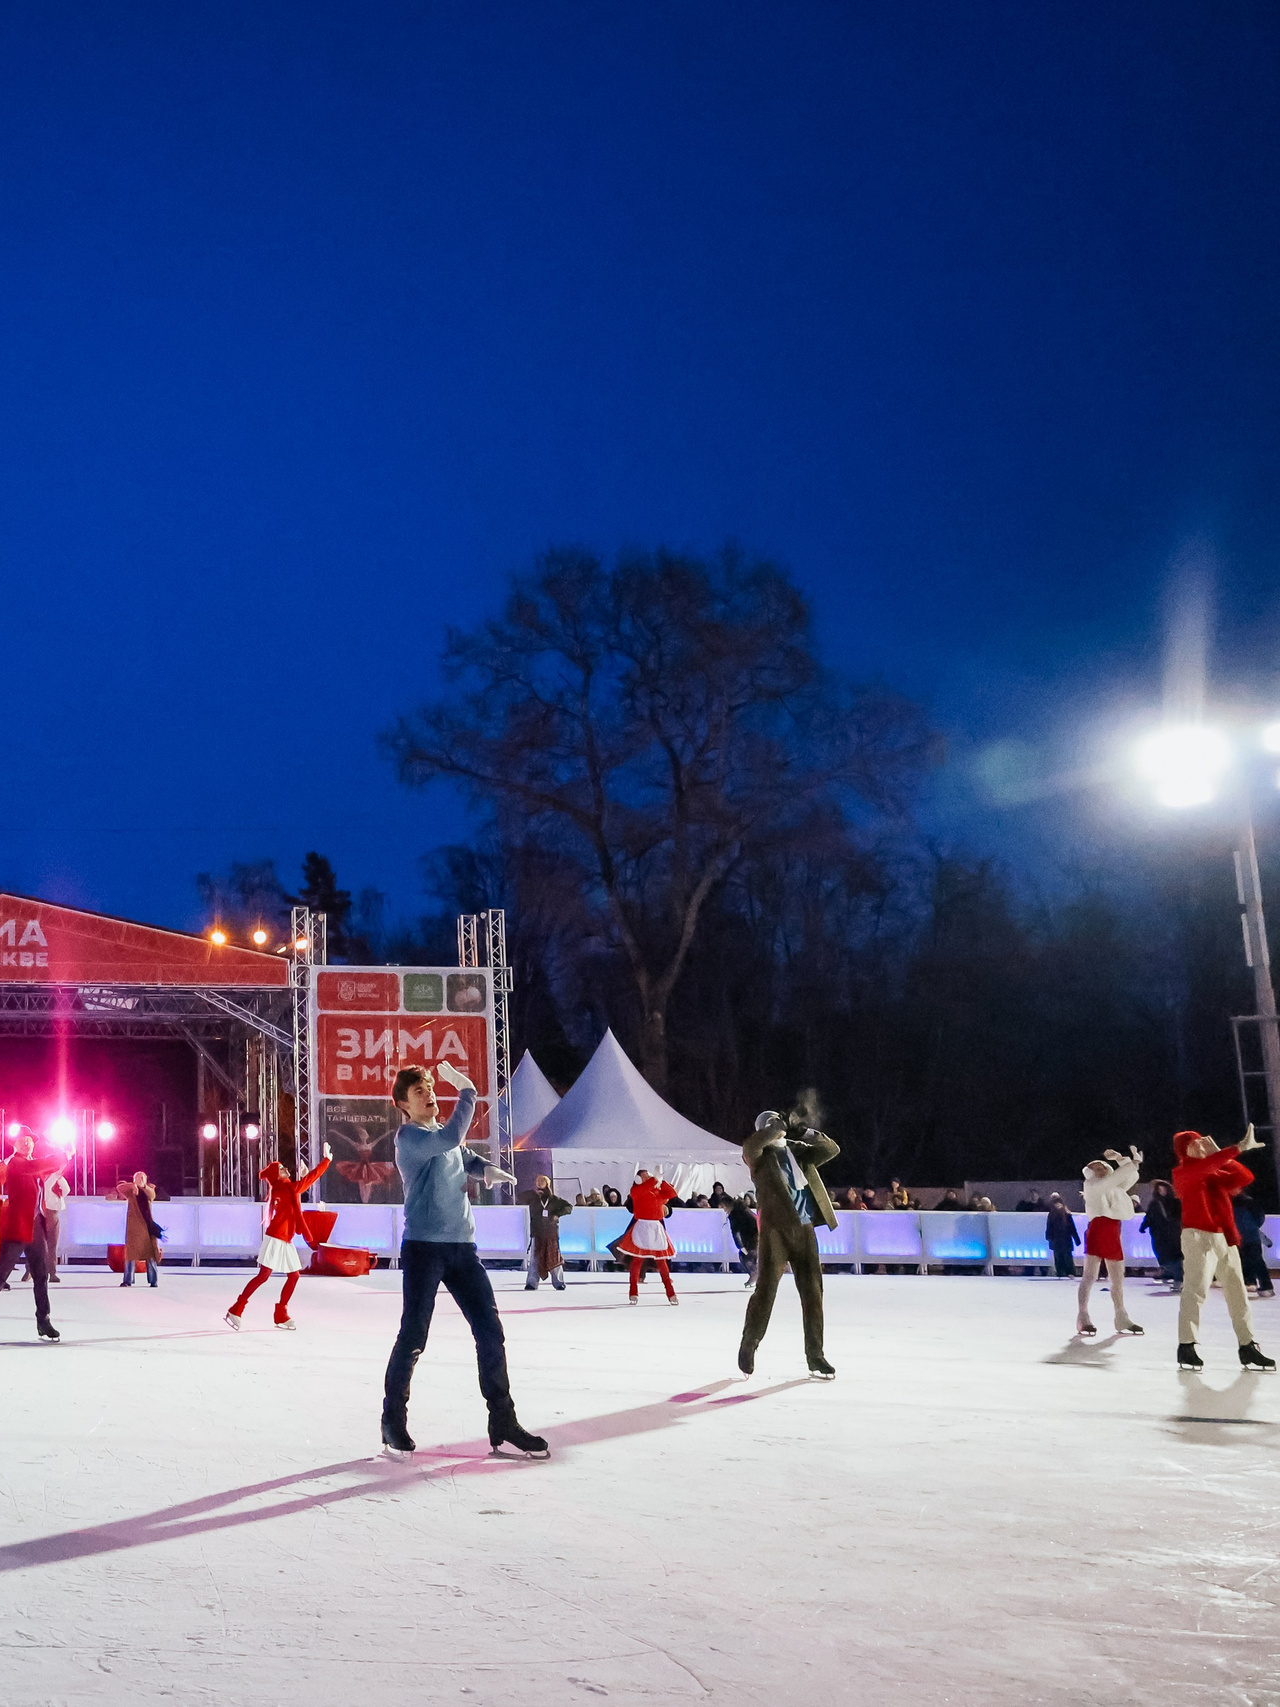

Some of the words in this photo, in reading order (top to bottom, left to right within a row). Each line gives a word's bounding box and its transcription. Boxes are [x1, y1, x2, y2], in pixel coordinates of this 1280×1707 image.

[336, 1028, 469, 1061] ЗИМА
[336, 1064, 353, 1081] В
[326, 1105, 347, 1113] ВСЕ
